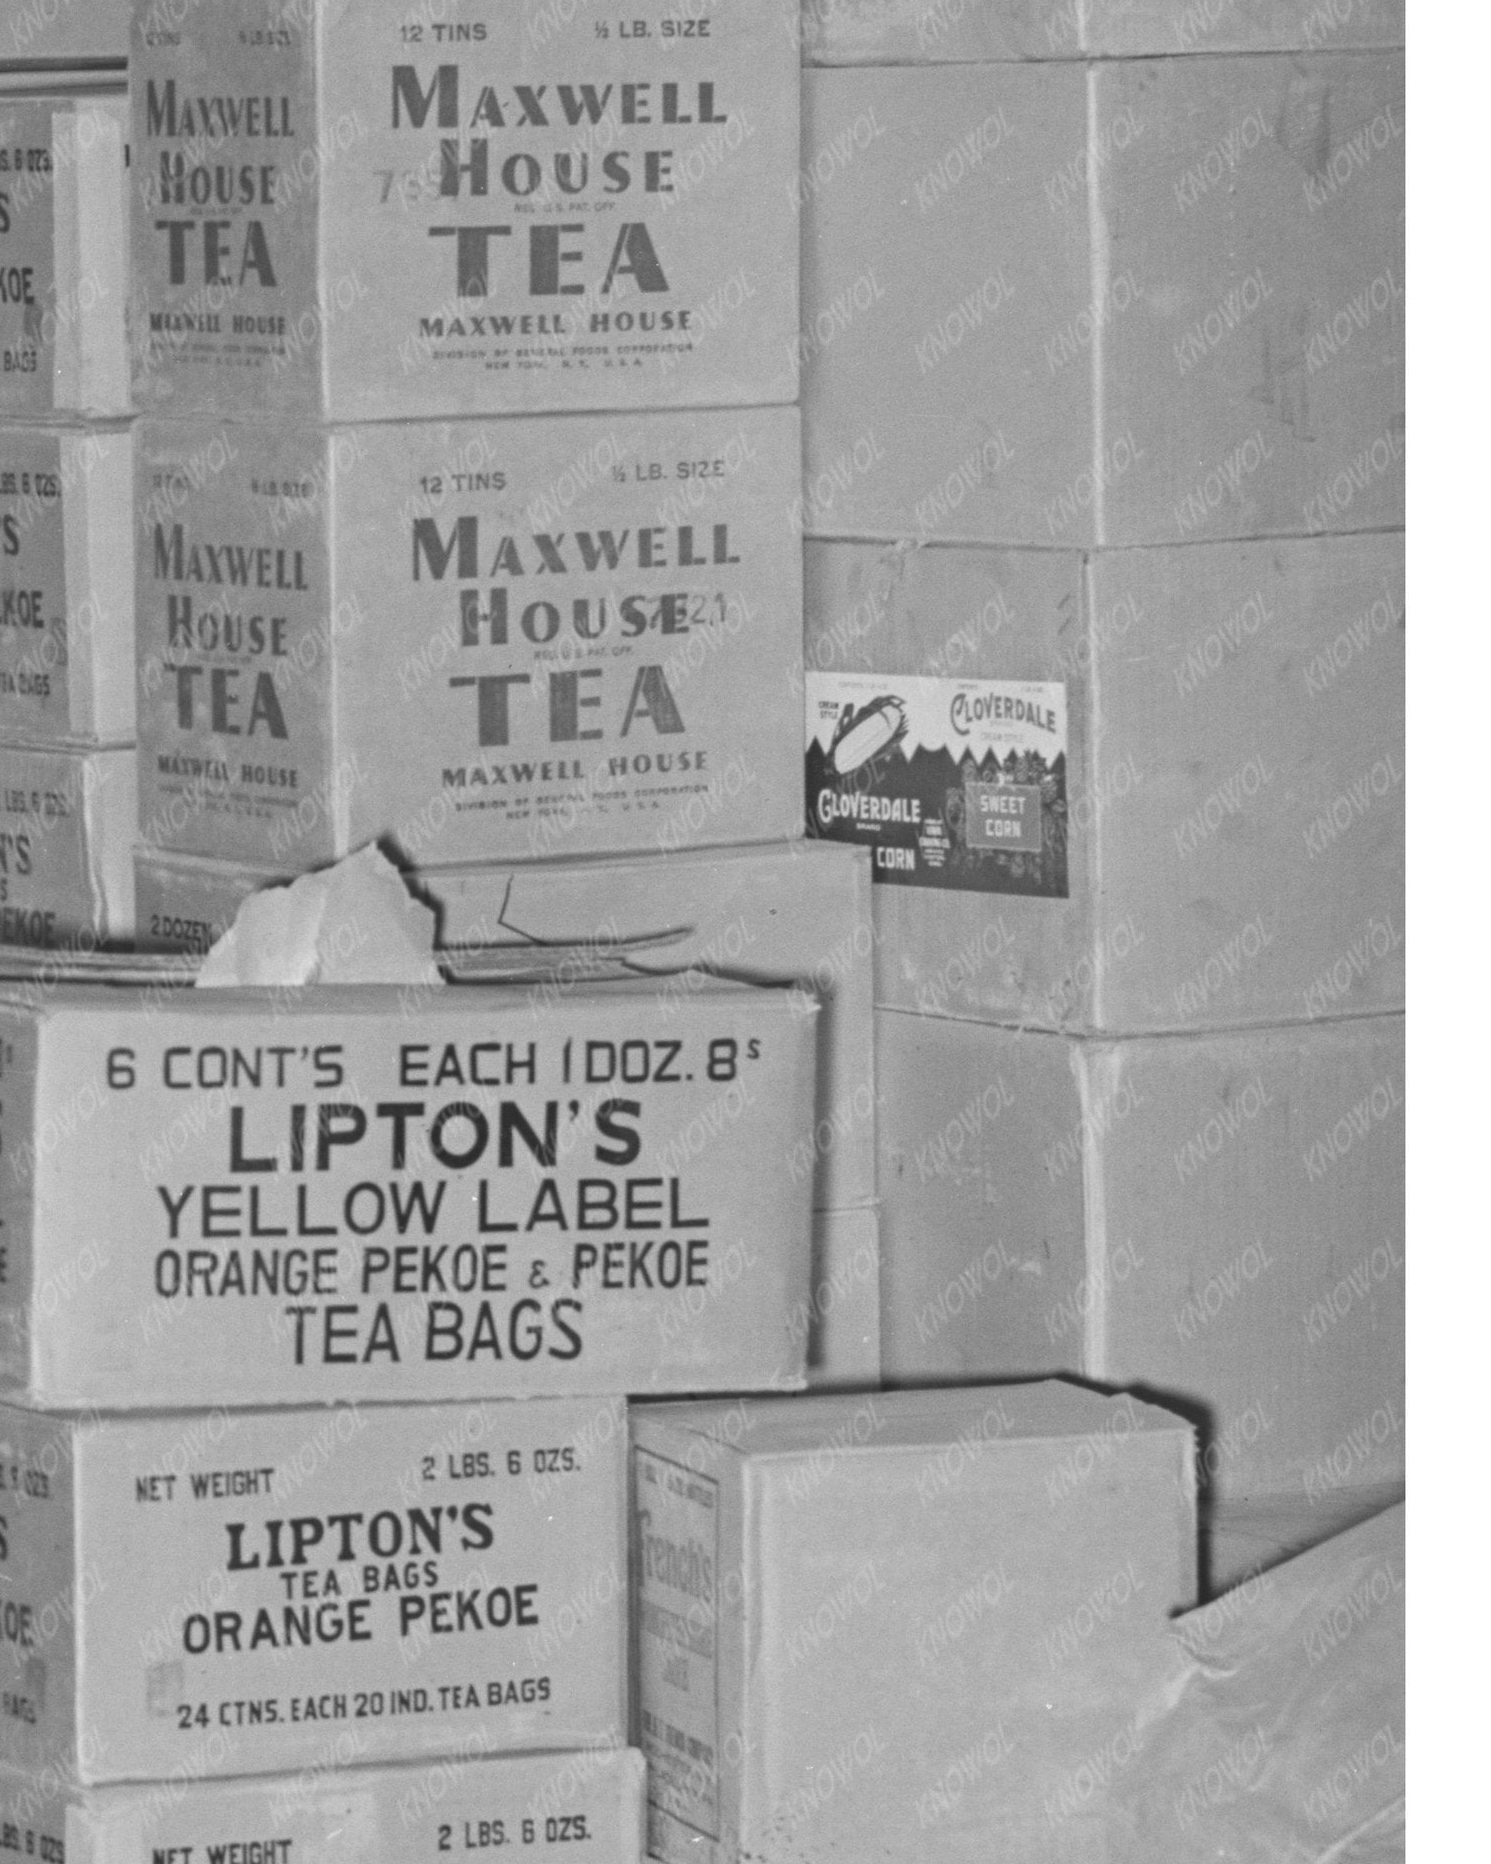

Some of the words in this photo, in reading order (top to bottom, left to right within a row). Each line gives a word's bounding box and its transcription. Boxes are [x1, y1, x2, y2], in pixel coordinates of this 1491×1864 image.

[401, 25, 423, 42] 12
[432, 23, 487, 42] TINS
[619, 20, 651, 38] LB.
[661, 19, 710, 37] SIZE
[145, 79, 295, 140] MAXWELL
[389, 64, 728, 131] MAXWELL
[160, 152, 278, 207] HOUSE
[440, 138, 673, 198] HOUSE
[154, 222, 278, 289] TEA
[429, 223, 669, 297] TEA
[420, 314, 565, 337] MAXWELL
[590, 311, 690, 332] HOUSE
[818, 790, 921, 823] CLOVERDALE
[877, 847, 915, 870] CORN
[107, 1048, 135, 1090] 6
[163, 1045, 343, 1089] CONT'S
[400, 1042, 535, 1087] EACH
[564, 1041, 571, 1083] 1
[586, 1040, 693, 1083] DOZ.
[230, 1098, 643, 1174] LIPTON'S
[158, 1180, 446, 1238] YELLOW
[478, 1177, 709, 1233] LABEL
[155, 1248, 337, 1298] ORANGE
[362, 1244, 507, 1293] PEKOE
[529, 1260, 549, 1289] &
[573, 1240, 708, 1289] PEKOE
[286, 1304, 401, 1366] TEA
[425, 1298, 585, 1361] BAGS
[136, 1476, 176, 1502] NET
[190, 1468, 275, 1500] WEIGHT
[421, 1457, 435, 1482] 2
[448, 1452, 496, 1480] LBS.
[508, 1451, 522, 1476] 6
[532, 1447, 582, 1475] OZS.
[224, 1504, 496, 1571] LIPTON'S
[176, 1703, 211, 1731] 24
[218, 1699, 286, 1727] CTNS.
[290, 1695, 348, 1722] EACH
[353, 1691, 383, 1718] 20
[389, 1688, 435, 1715] IND.
[438, 1684, 482, 1710] TEA
[486, 1677, 552, 1707] BAGS
